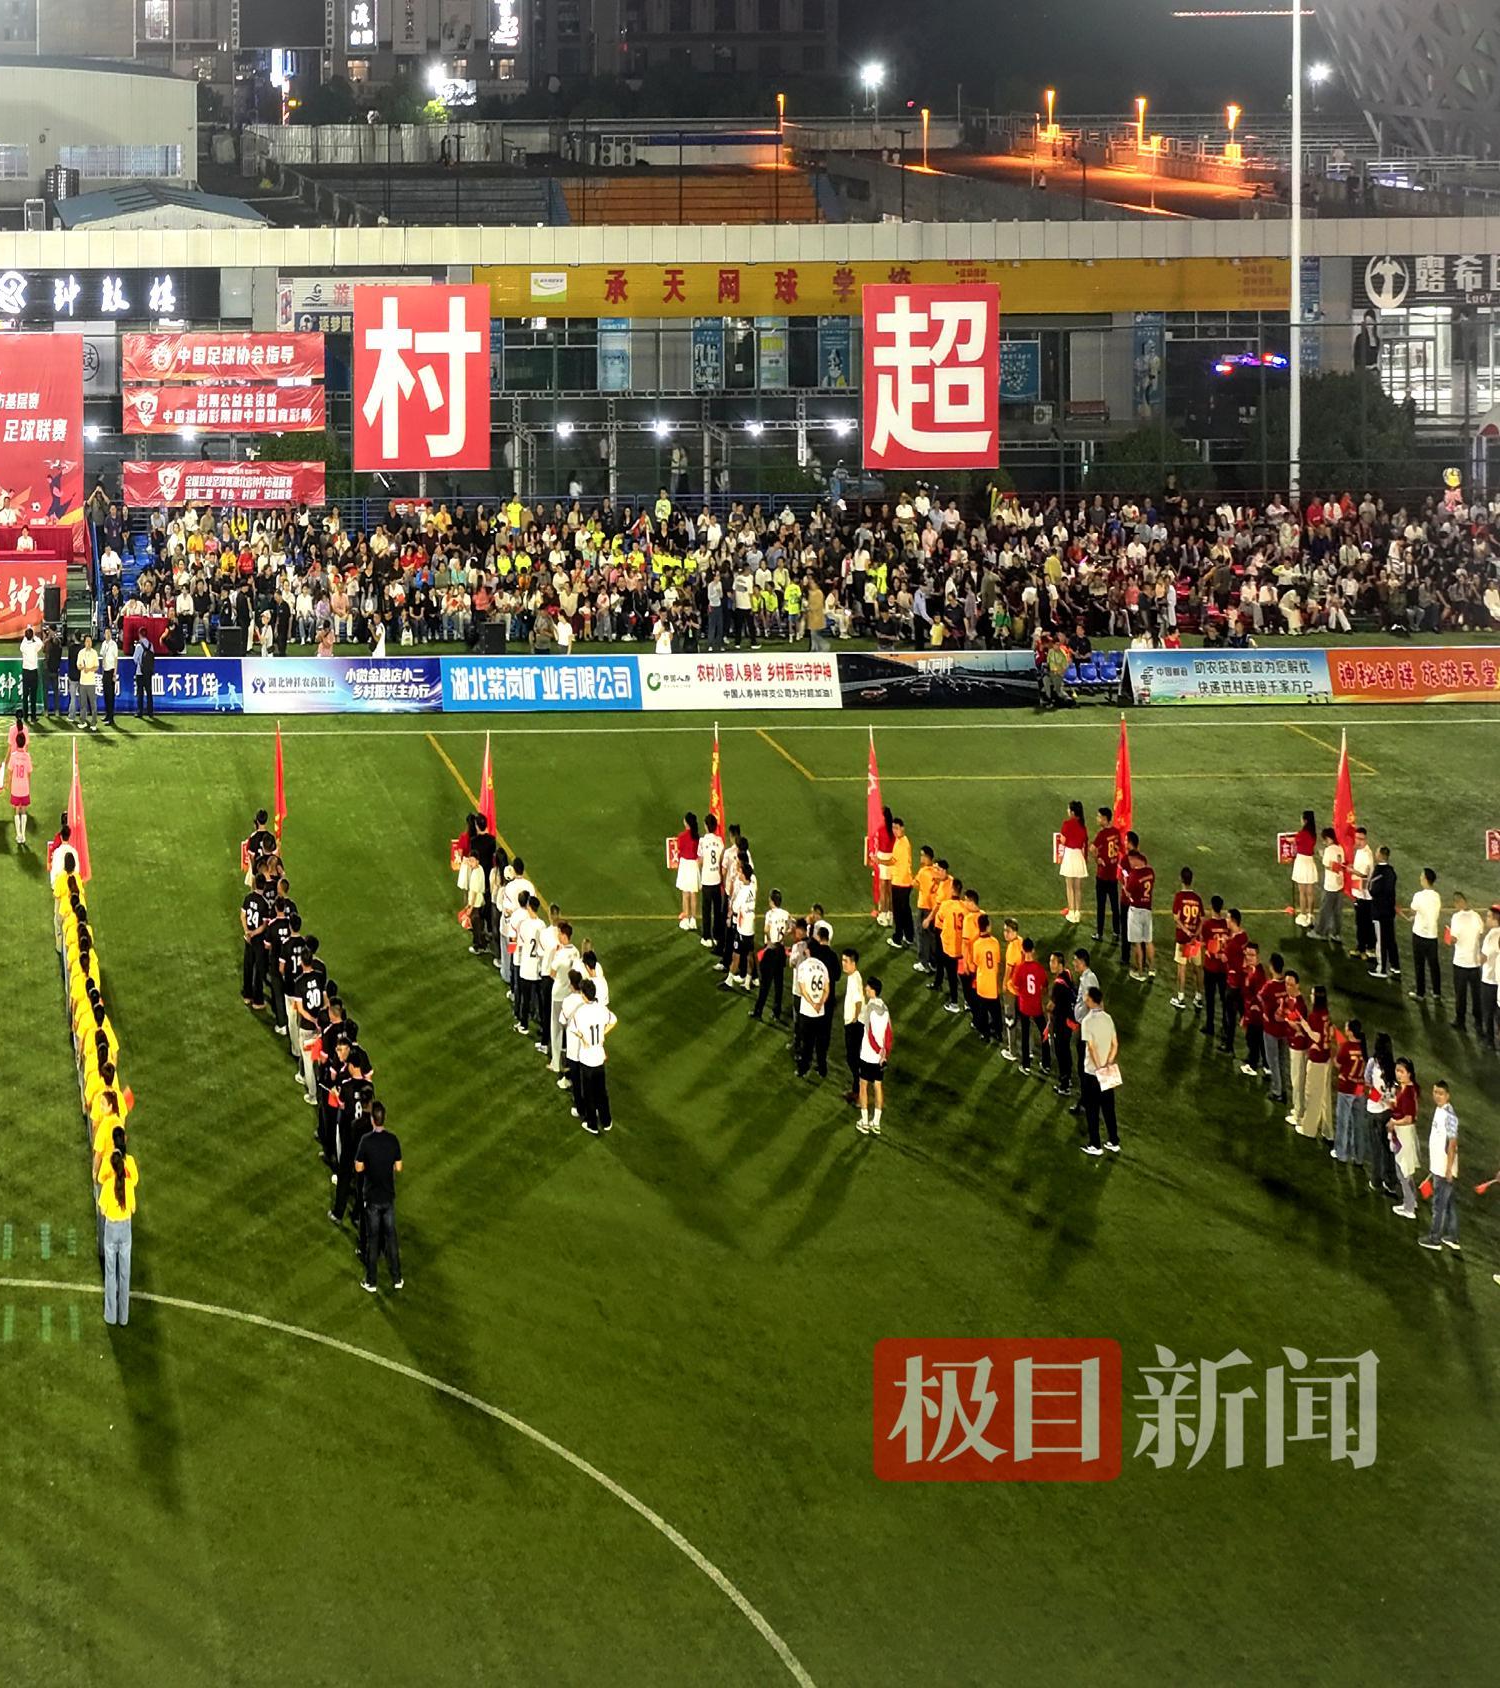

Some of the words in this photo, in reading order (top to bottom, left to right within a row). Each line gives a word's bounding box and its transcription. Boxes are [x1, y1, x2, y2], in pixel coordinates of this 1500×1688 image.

[177, 345, 295, 366] 中国足球协会指导
[363, 297, 482, 460] 村
[871, 296, 993, 458] 超
[197, 393, 277, 408] 彩票公益金资助
[162, 408, 312, 424] 中国福利彩票和中国体育彩票
[344, 668, 425, 684] 小微金融店小二
[1338, 660, 1415, 690] 神秘钟祥
[1421, 658, 1498, 688] 旅游天堂
[352, 684, 431, 700] 乡村振兴主办行
[450, 667, 631, 701] 湖北紫岗矿业有限公司
[1198, 680, 1313, 694] 快递进村连接千家万户
[246, 909, 260, 928] 24
[1182, 904, 1199, 923] 99
[810, 975, 824, 991] 66
[1026, 974, 1036, 994] 6
[306, 988, 321, 1011] 30
[590, 1024, 600, 1045] 11
